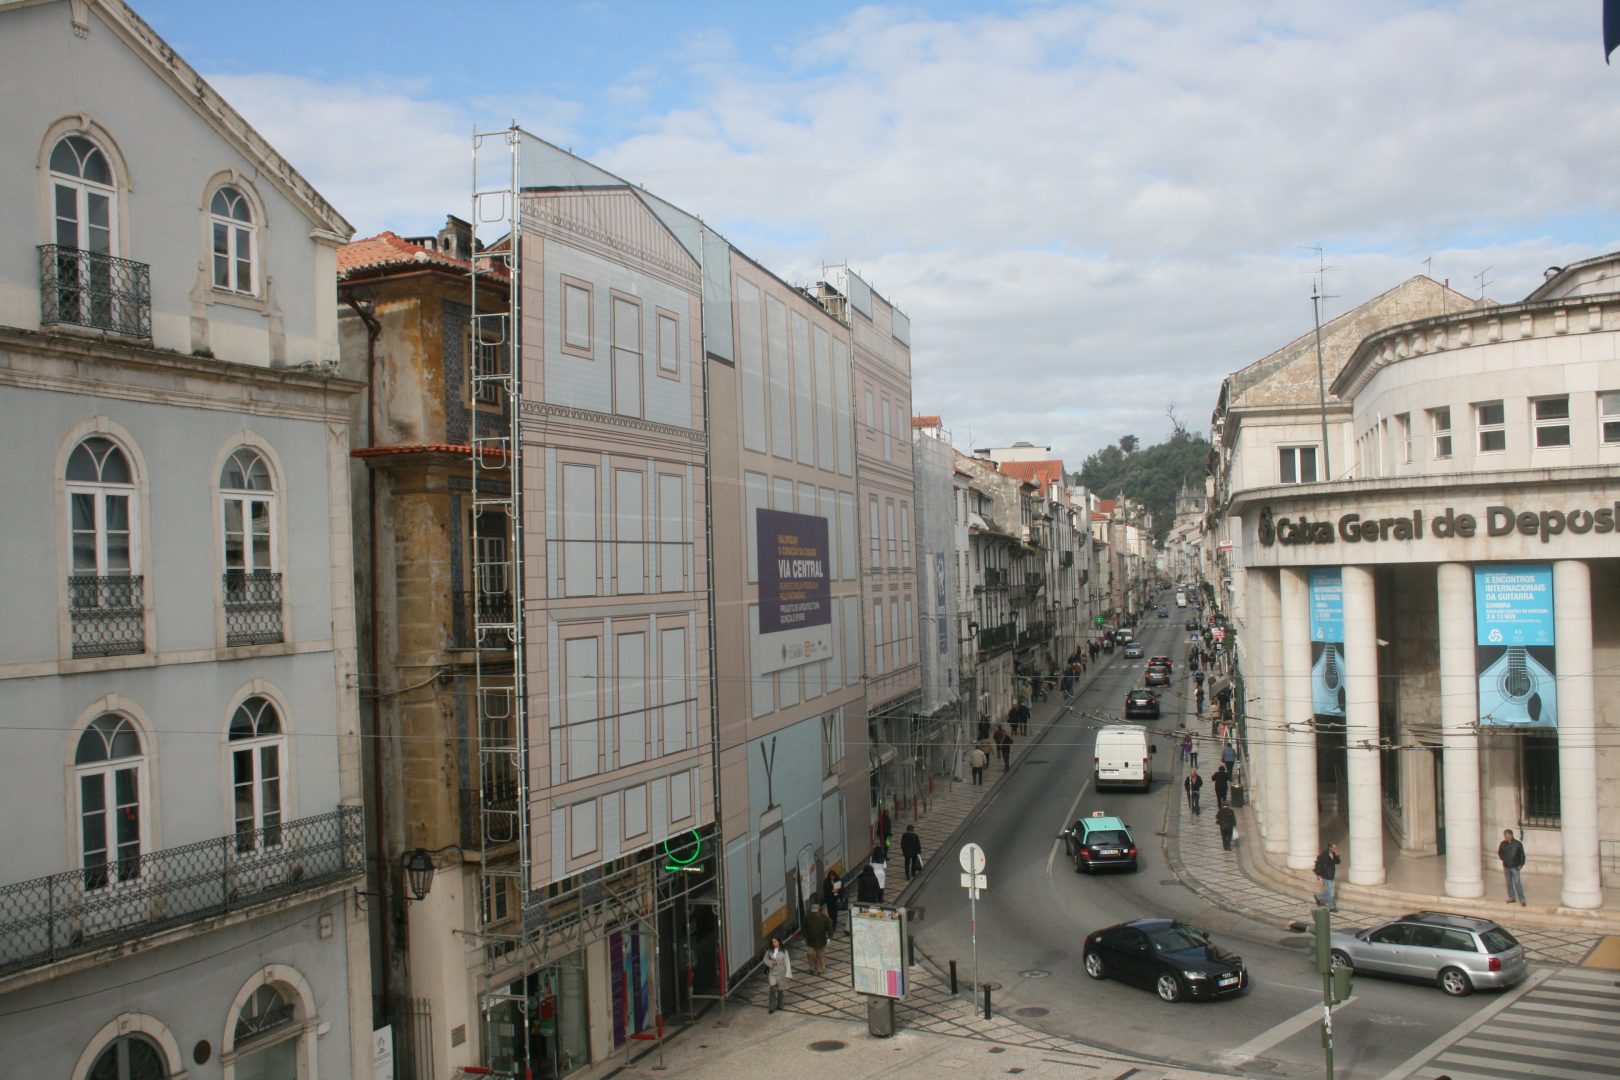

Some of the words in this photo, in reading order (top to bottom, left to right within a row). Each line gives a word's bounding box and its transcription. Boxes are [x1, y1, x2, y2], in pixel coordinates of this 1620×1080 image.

[1277, 516, 1335, 545] Caixa
[1338, 509, 1423, 543] Geral
[1431, 507, 1477, 539] de
[778, 559, 791, 578] VIA
[792, 559, 824, 578] CENTRAL
[1491, 576, 1536, 584] ENCONTROS
[1485, 584, 1547, 593] INTERNACIONAIS
[1486, 593, 1497, 601] DA
[1498, 593, 1534, 601] GUITARRA
